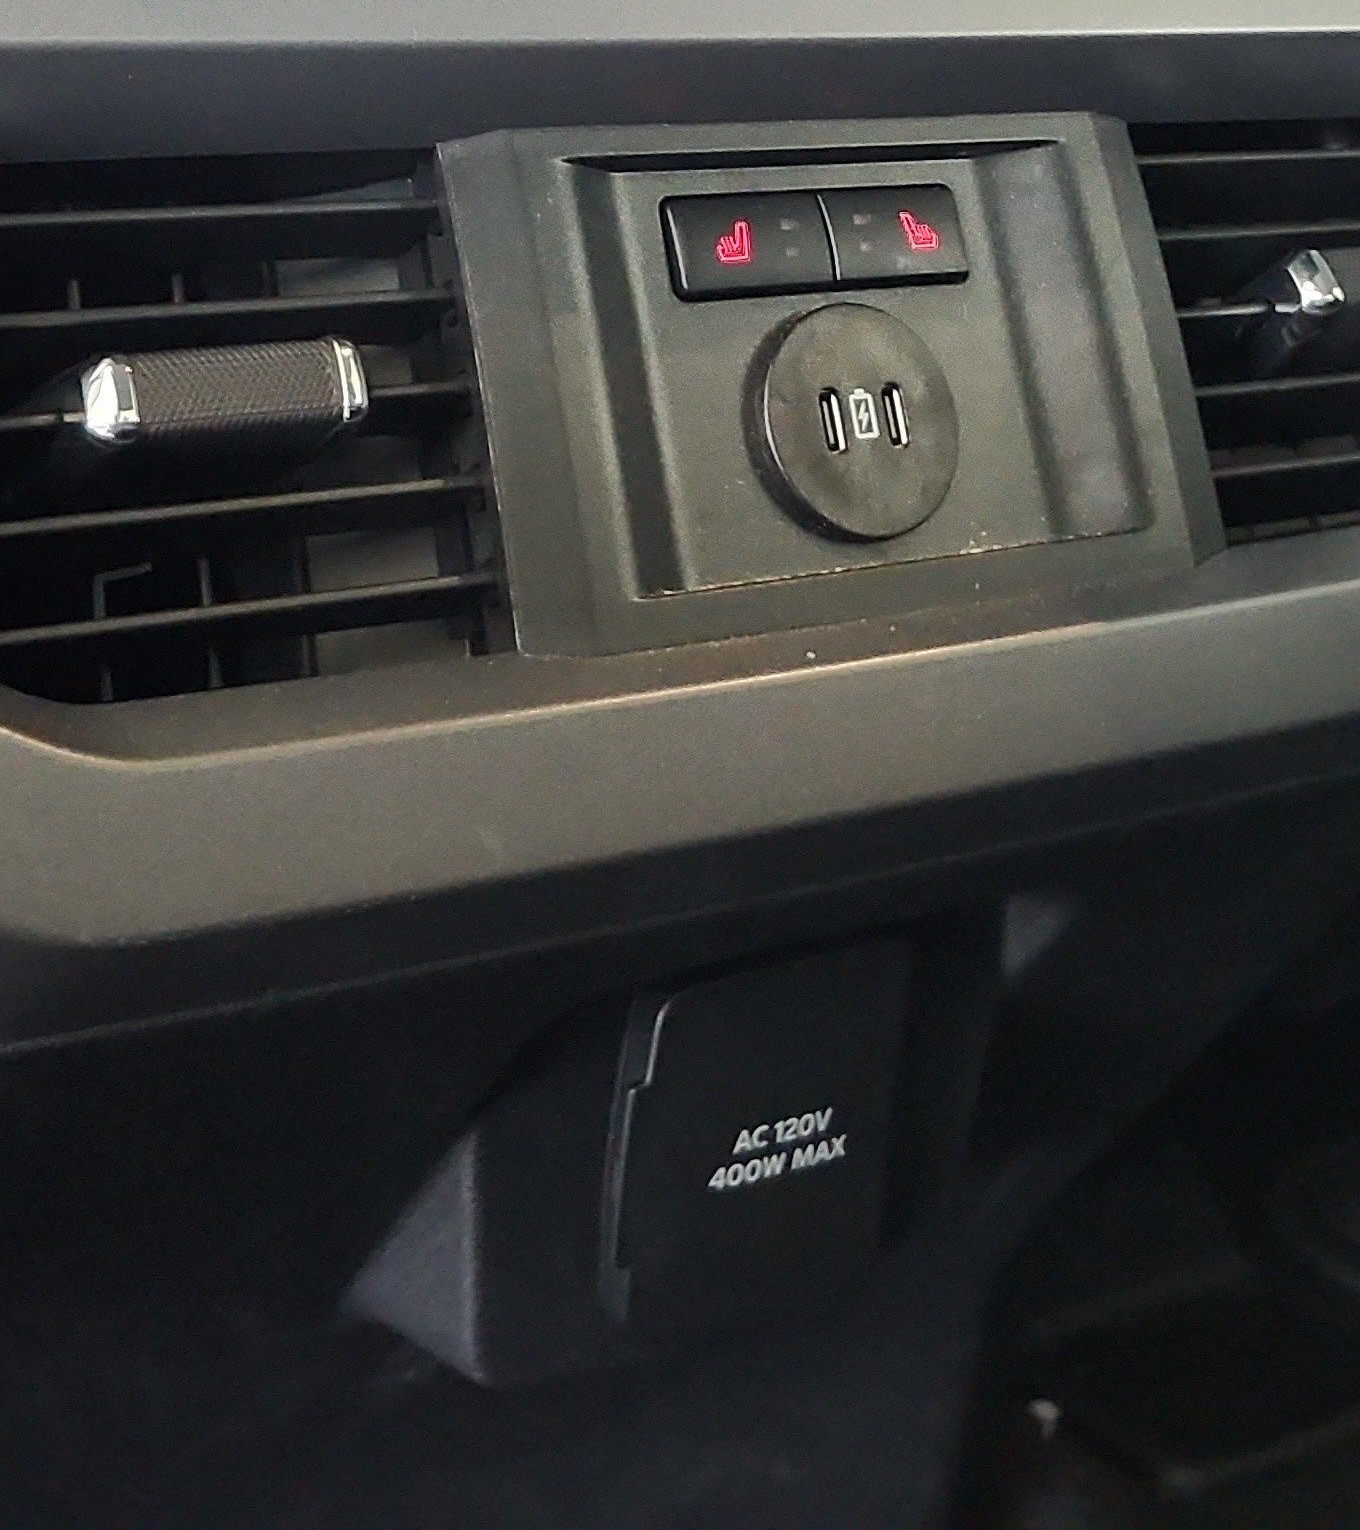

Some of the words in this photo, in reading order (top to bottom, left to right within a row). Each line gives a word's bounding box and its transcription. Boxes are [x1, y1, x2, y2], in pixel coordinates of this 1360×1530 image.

[732, 1124, 770, 1155] AC
[773, 1106, 834, 1144] 120V
[707, 1151, 787, 1190] 400W
[790, 1133, 848, 1171] MAX
